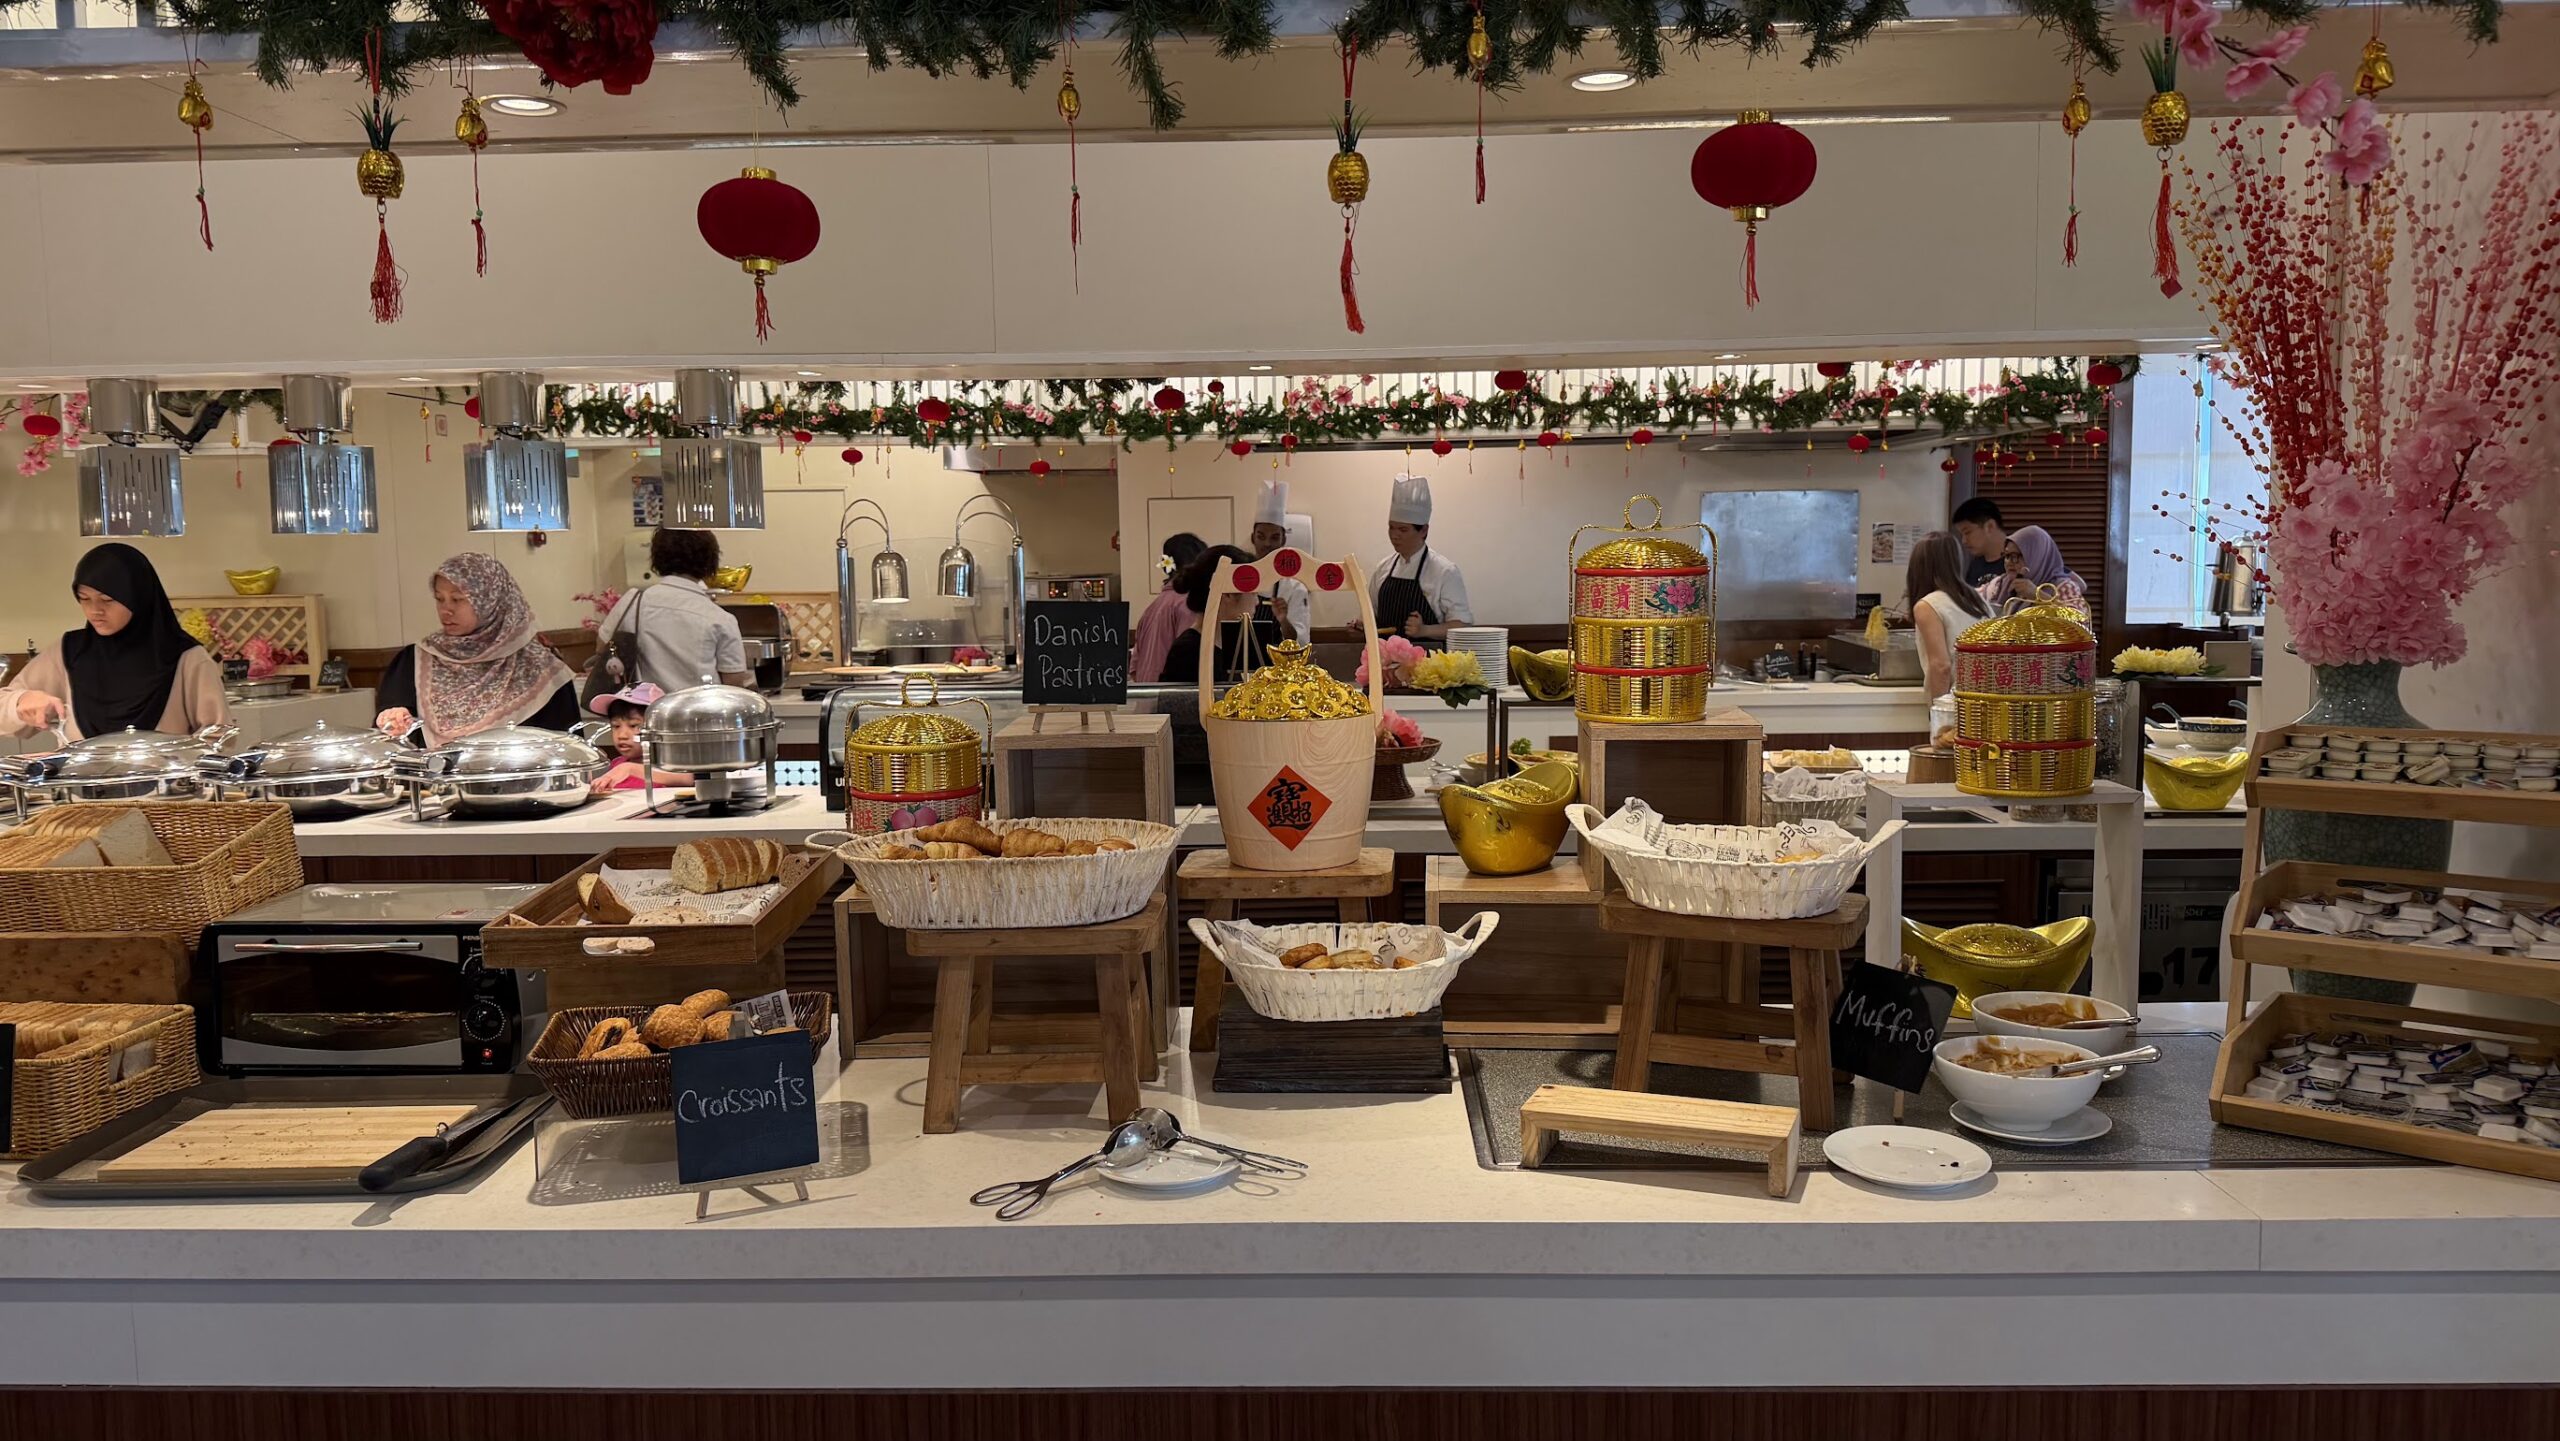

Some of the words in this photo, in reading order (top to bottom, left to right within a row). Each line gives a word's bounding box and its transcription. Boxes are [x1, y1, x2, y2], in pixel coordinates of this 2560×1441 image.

[1034, 614, 1119, 647] Danish
[1038, 653, 1123, 689] Pastries
[1835, 990, 1935, 1053] Muffins
[678, 1061, 808, 1124] Croissants
